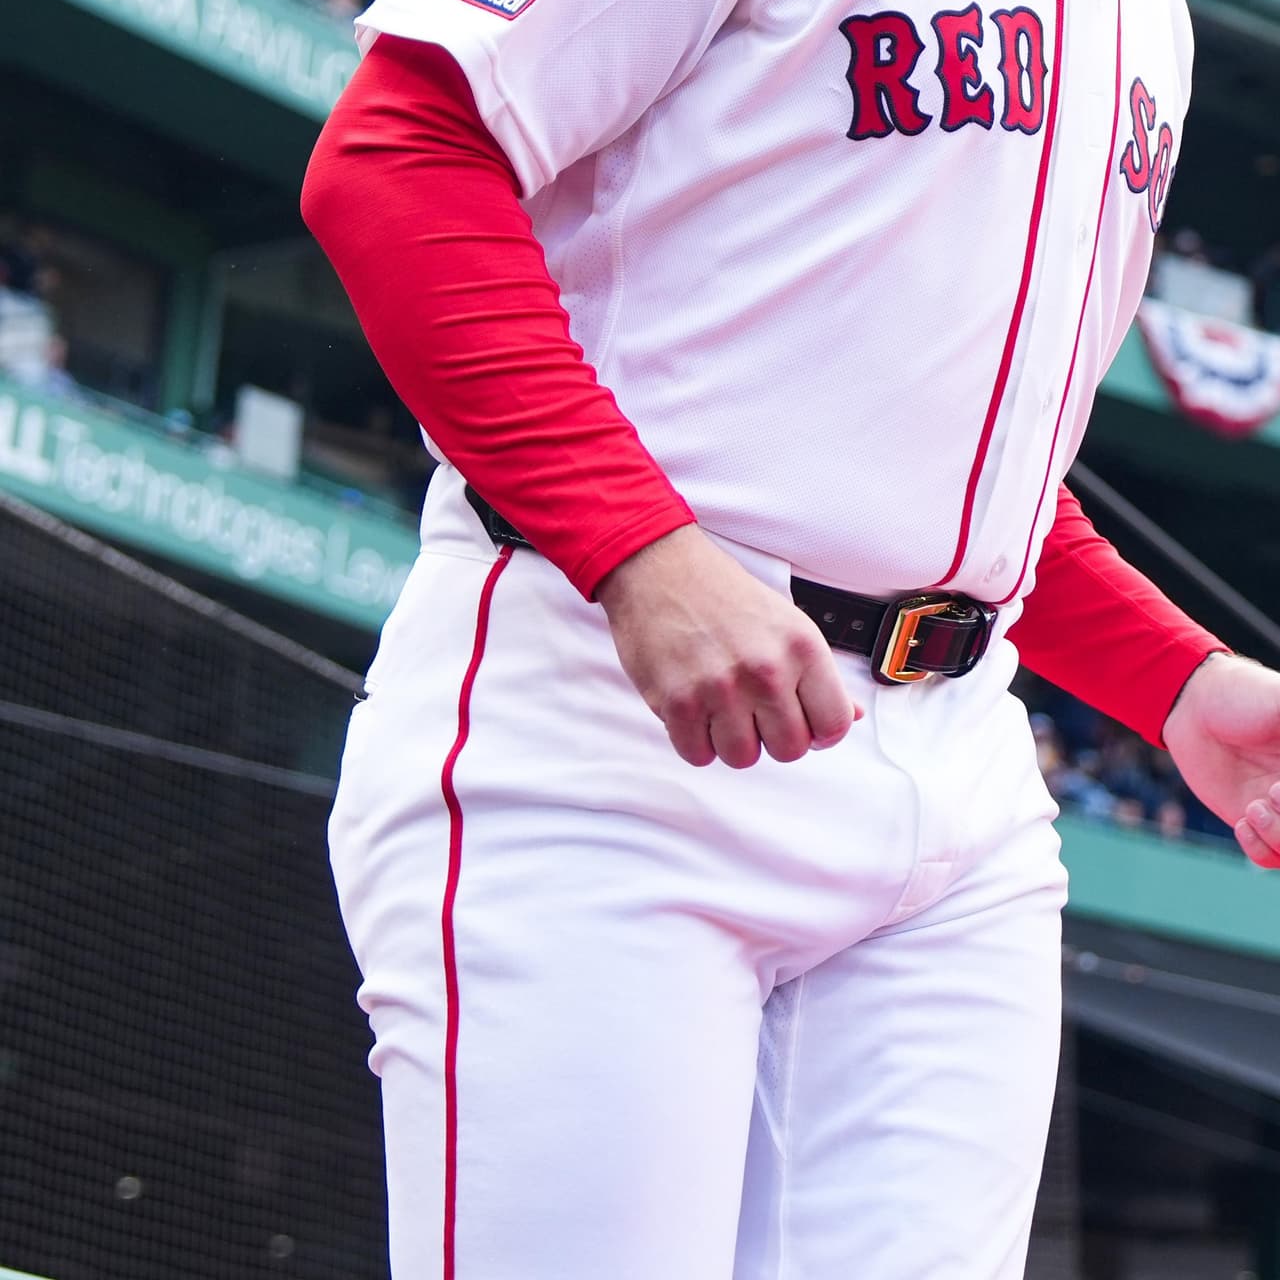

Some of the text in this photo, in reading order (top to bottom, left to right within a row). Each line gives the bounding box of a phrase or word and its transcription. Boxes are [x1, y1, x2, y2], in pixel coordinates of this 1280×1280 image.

[838, 1, 1176, 234] RED SO
[0, 392, 53, 486] LL
[54, 414, 326, 582] Technologies
